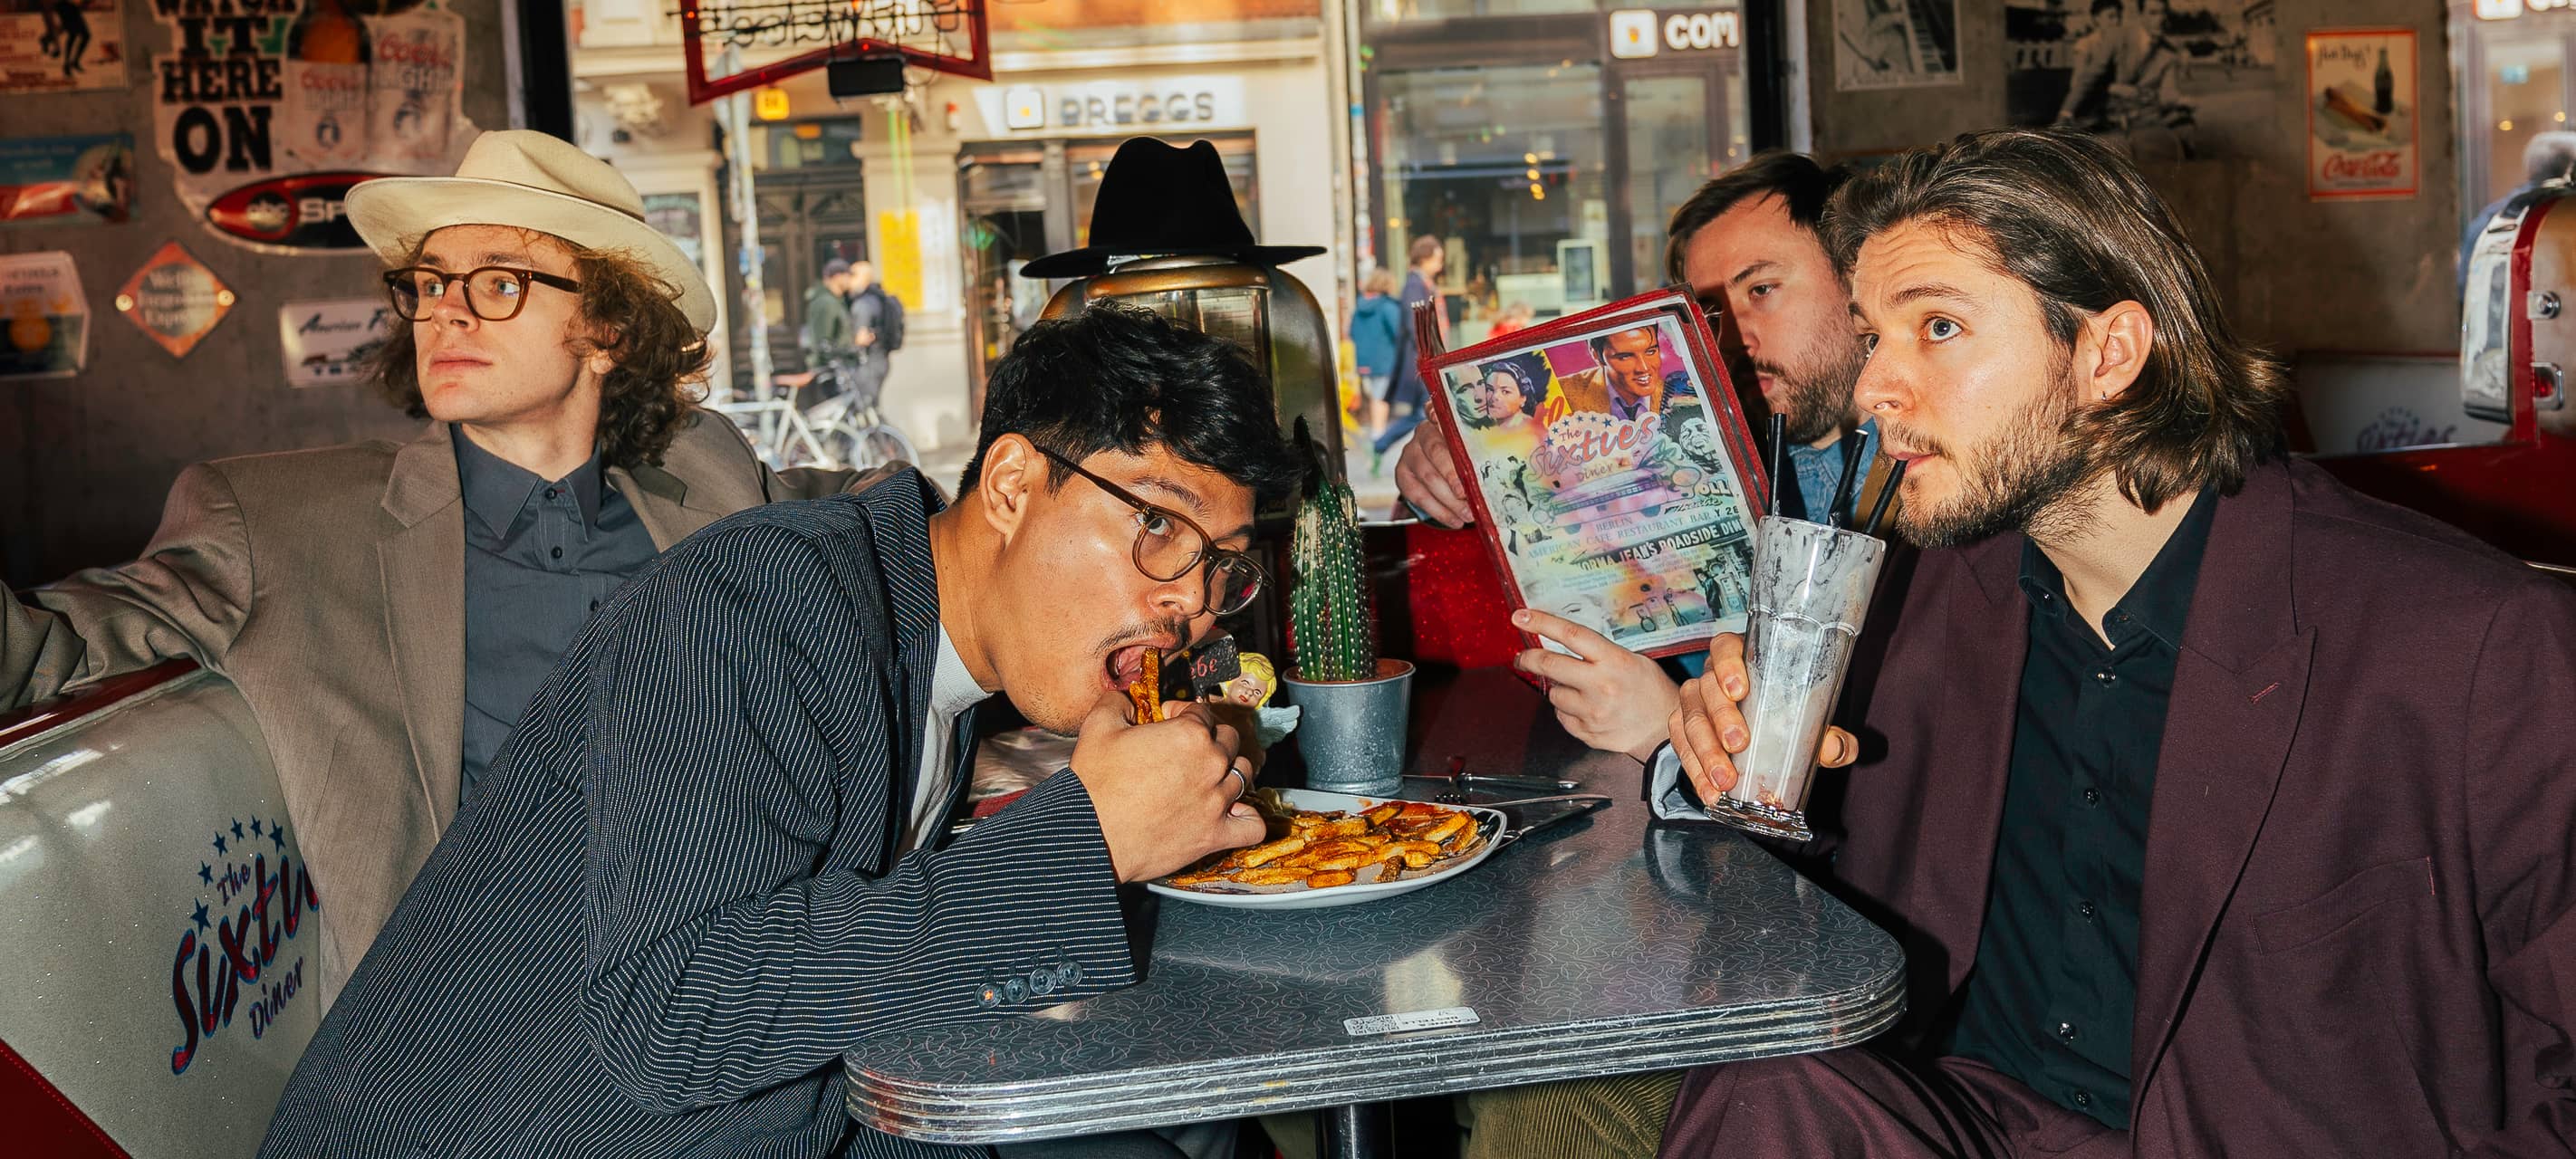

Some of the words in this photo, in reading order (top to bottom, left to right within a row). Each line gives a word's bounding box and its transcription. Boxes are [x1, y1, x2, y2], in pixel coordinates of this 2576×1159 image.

[179, 16, 269, 58] IT
[1665, 11, 1740, 50] COM
[160, 59, 283, 105] HERE
[173, 106, 272, 174] ON
[1527, 415, 1657, 483] Sixties
[1559, 427, 1583, 442] The
[1596, 515, 1633, 532] BERLIN
[1617, 518, 1683, 539] RESTAURANT
[217, 863, 251, 906] The
[249, 956, 303, 1039] Diner
